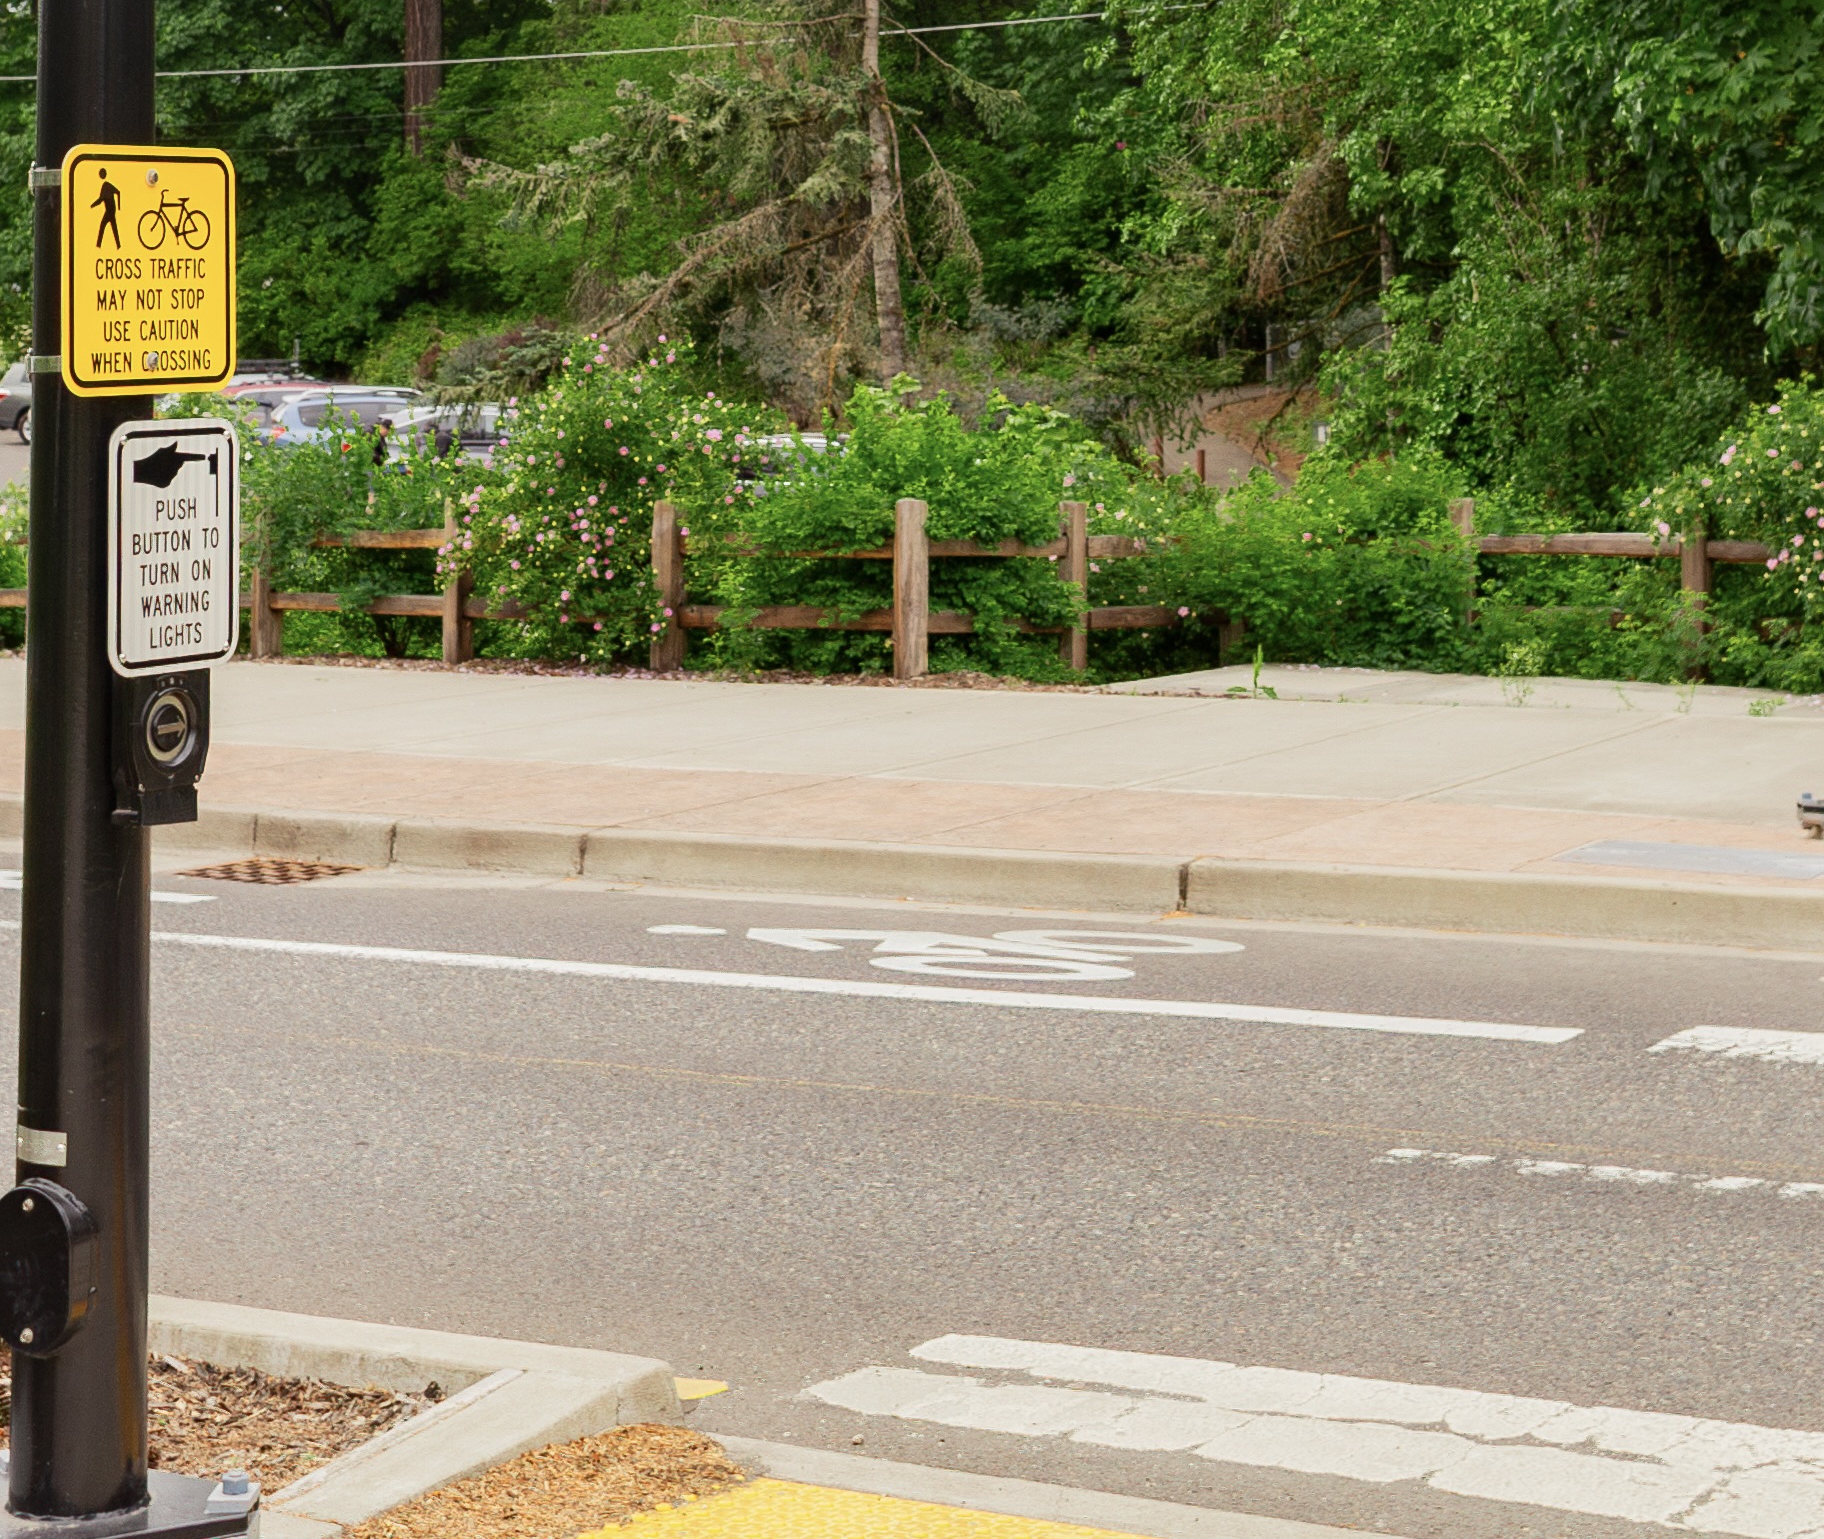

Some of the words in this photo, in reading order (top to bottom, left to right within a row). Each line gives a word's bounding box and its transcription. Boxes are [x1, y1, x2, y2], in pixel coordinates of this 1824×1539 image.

[95, 258, 142, 279] CROSS
[149, 258, 206, 279] TRAFFIC
[96, 289, 127, 311] MAY
[136, 289, 163, 310] NOT
[171, 288, 205, 310] STOP
[103, 320, 131, 342] USE
[139, 319, 199, 341] CAUTION
[91, 351, 132, 374] WHEN
[155, 497, 197, 521] PUSH
[132, 530, 191, 555] BUTTON
[202, 527, 219, 549] TO
[140, 561, 180, 587] TURN
[191, 559, 211, 582] ON
[141, 590, 210, 618] WARNING
[150, 622, 203, 649] LIGHTS
